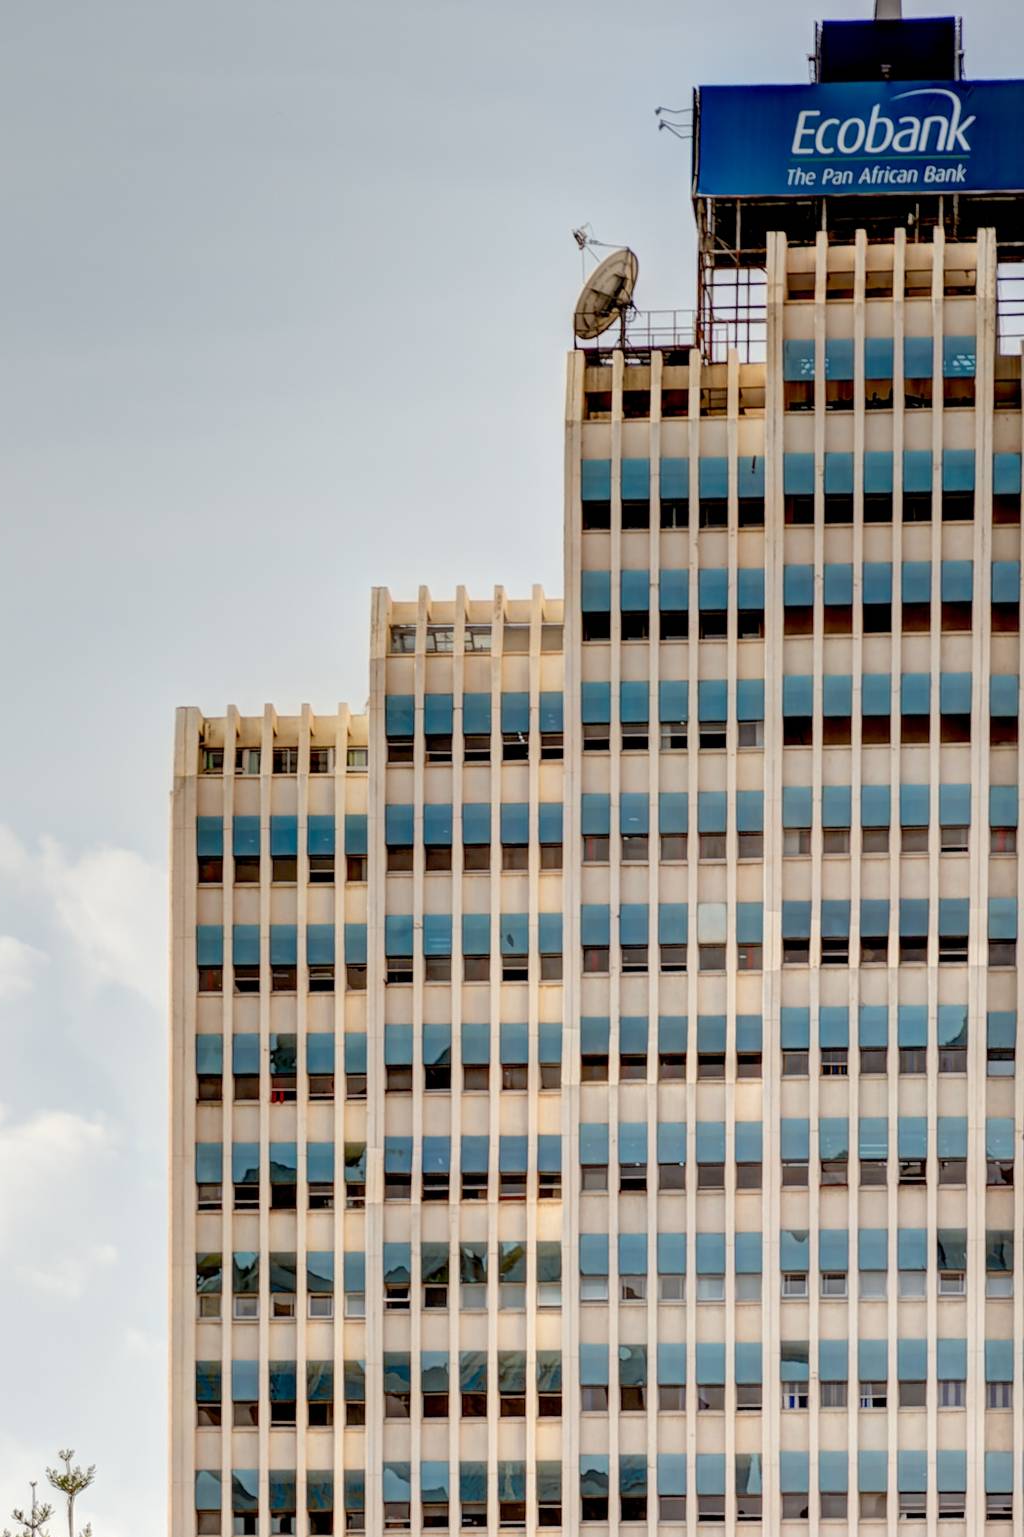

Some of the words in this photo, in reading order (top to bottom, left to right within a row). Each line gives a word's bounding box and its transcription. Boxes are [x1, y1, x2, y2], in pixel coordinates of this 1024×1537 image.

[791, 88, 977, 155] Ecobank
[787, 167, 816, 186] The
[822, 168, 854, 186] Pan
[858, 165, 919, 185] African
[923, 163, 967, 184] Bank
